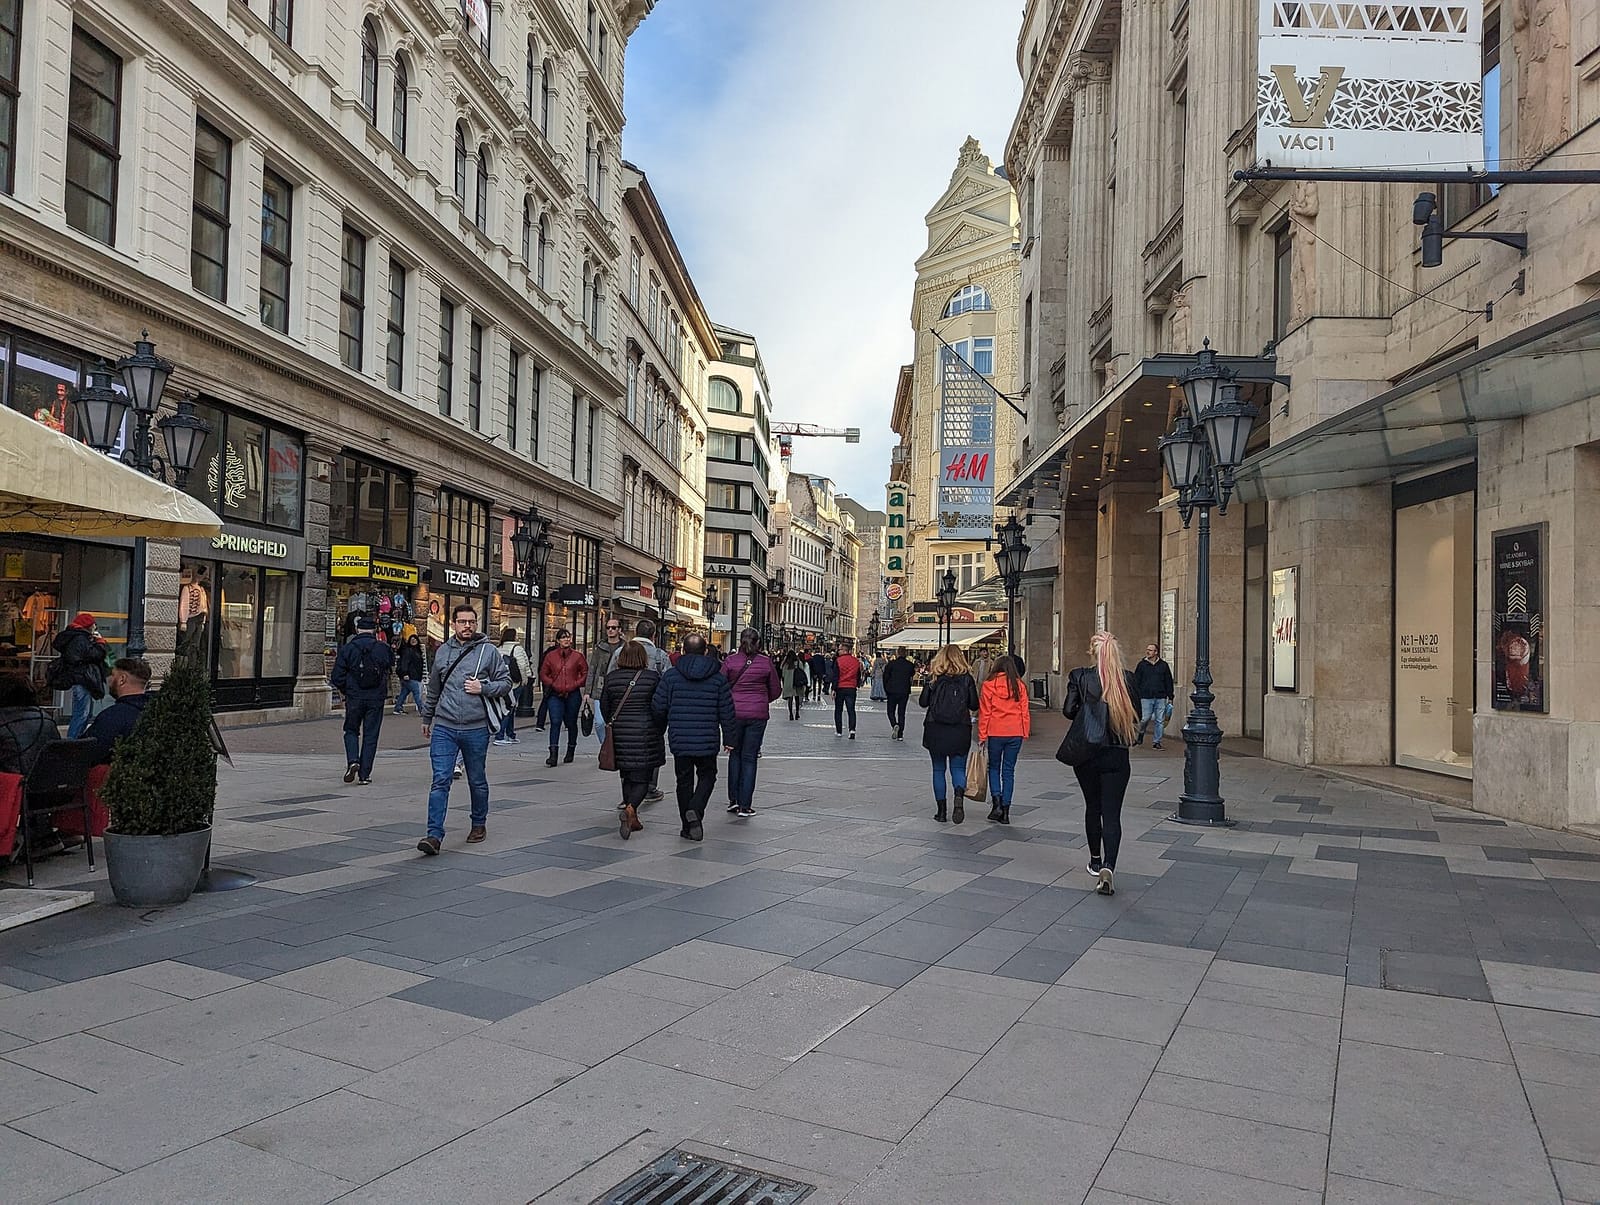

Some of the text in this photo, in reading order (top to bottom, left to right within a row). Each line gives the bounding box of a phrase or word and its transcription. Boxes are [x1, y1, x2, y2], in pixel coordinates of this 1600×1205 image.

[1278, 133, 1334, 151] VÁCI 1
[945, 453, 989, 482] H&M
[887, 491, 905, 571] anna
[211, 533, 287, 558] SPRINGFIELD
[707, 563, 738, 574] ARA
[444, 569, 480, 588] TEZENIS
[512, 581, 540, 598] TEZEIS
